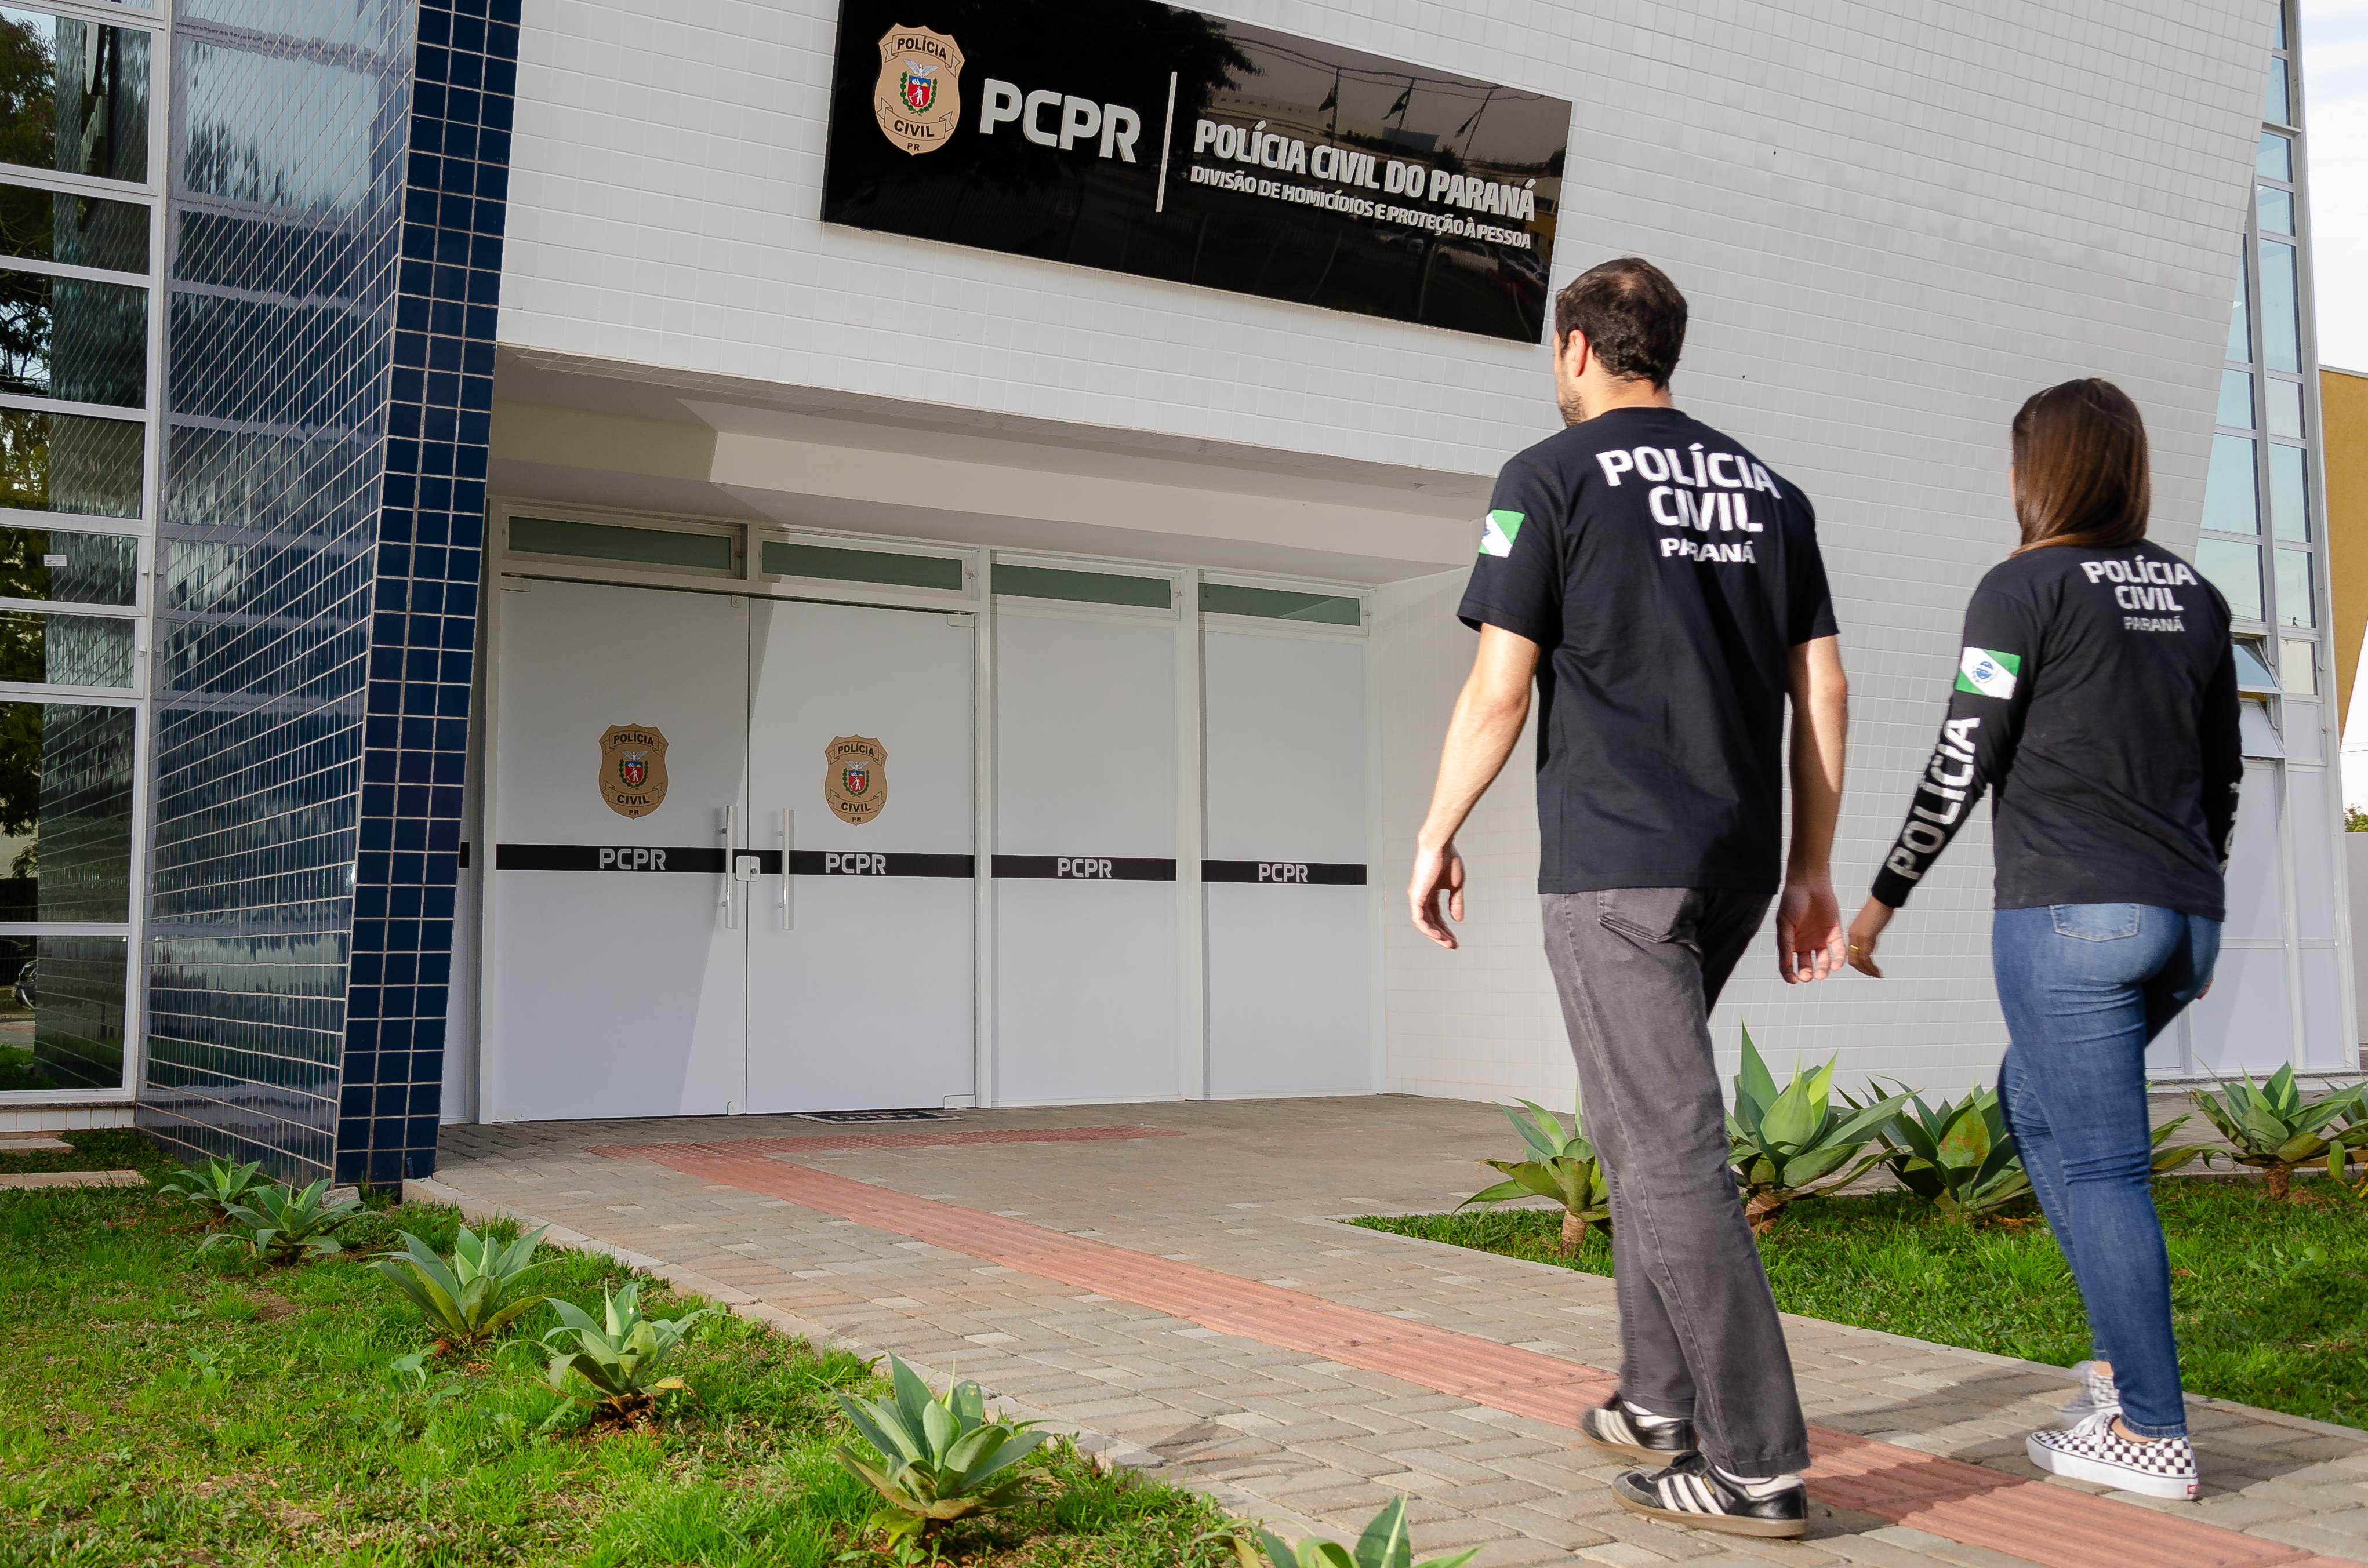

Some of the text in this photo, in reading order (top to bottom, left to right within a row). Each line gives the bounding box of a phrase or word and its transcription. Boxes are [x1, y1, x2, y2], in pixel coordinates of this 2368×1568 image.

[897, 37, 947, 60] POLÍCIA
[894, 119, 935, 138] CIVIL
[980, 78, 1141, 163] PCPR
[907, 142, 920, 152] PR
[1194, 119, 1535, 221] POLÍCIA CIVIL DO PARANÁ
[1190, 166, 1531, 249] DIVISÃO DE HOMICÍDIOS E PROTEÇÃO À PESSOA
[1595, 442, 1782, 499] POLÍCIA
[1648, 486, 1763, 532] CIVIL
[1660, 537, 1756, 563] PARANÁ
[2080, 555, 2198, 585] POLÍCIA
[2115, 585, 2184, 611] CIVIL
[2123, 615, 2185, 632] PARANÁ
[613, 731, 654, 747] POLÍCIA
[838, 742, 874, 757] POLÍCIA
[616, 794, 650, 805] CIVIL
[841, 802, 871, 813] CIVIL
[599, 848, 666, 871] PCPR
[825, 853, 886, 875] PCPR
[1058, 858, 1112, 878] PCPR
[1259, 863, 1308, 882] PCPR
